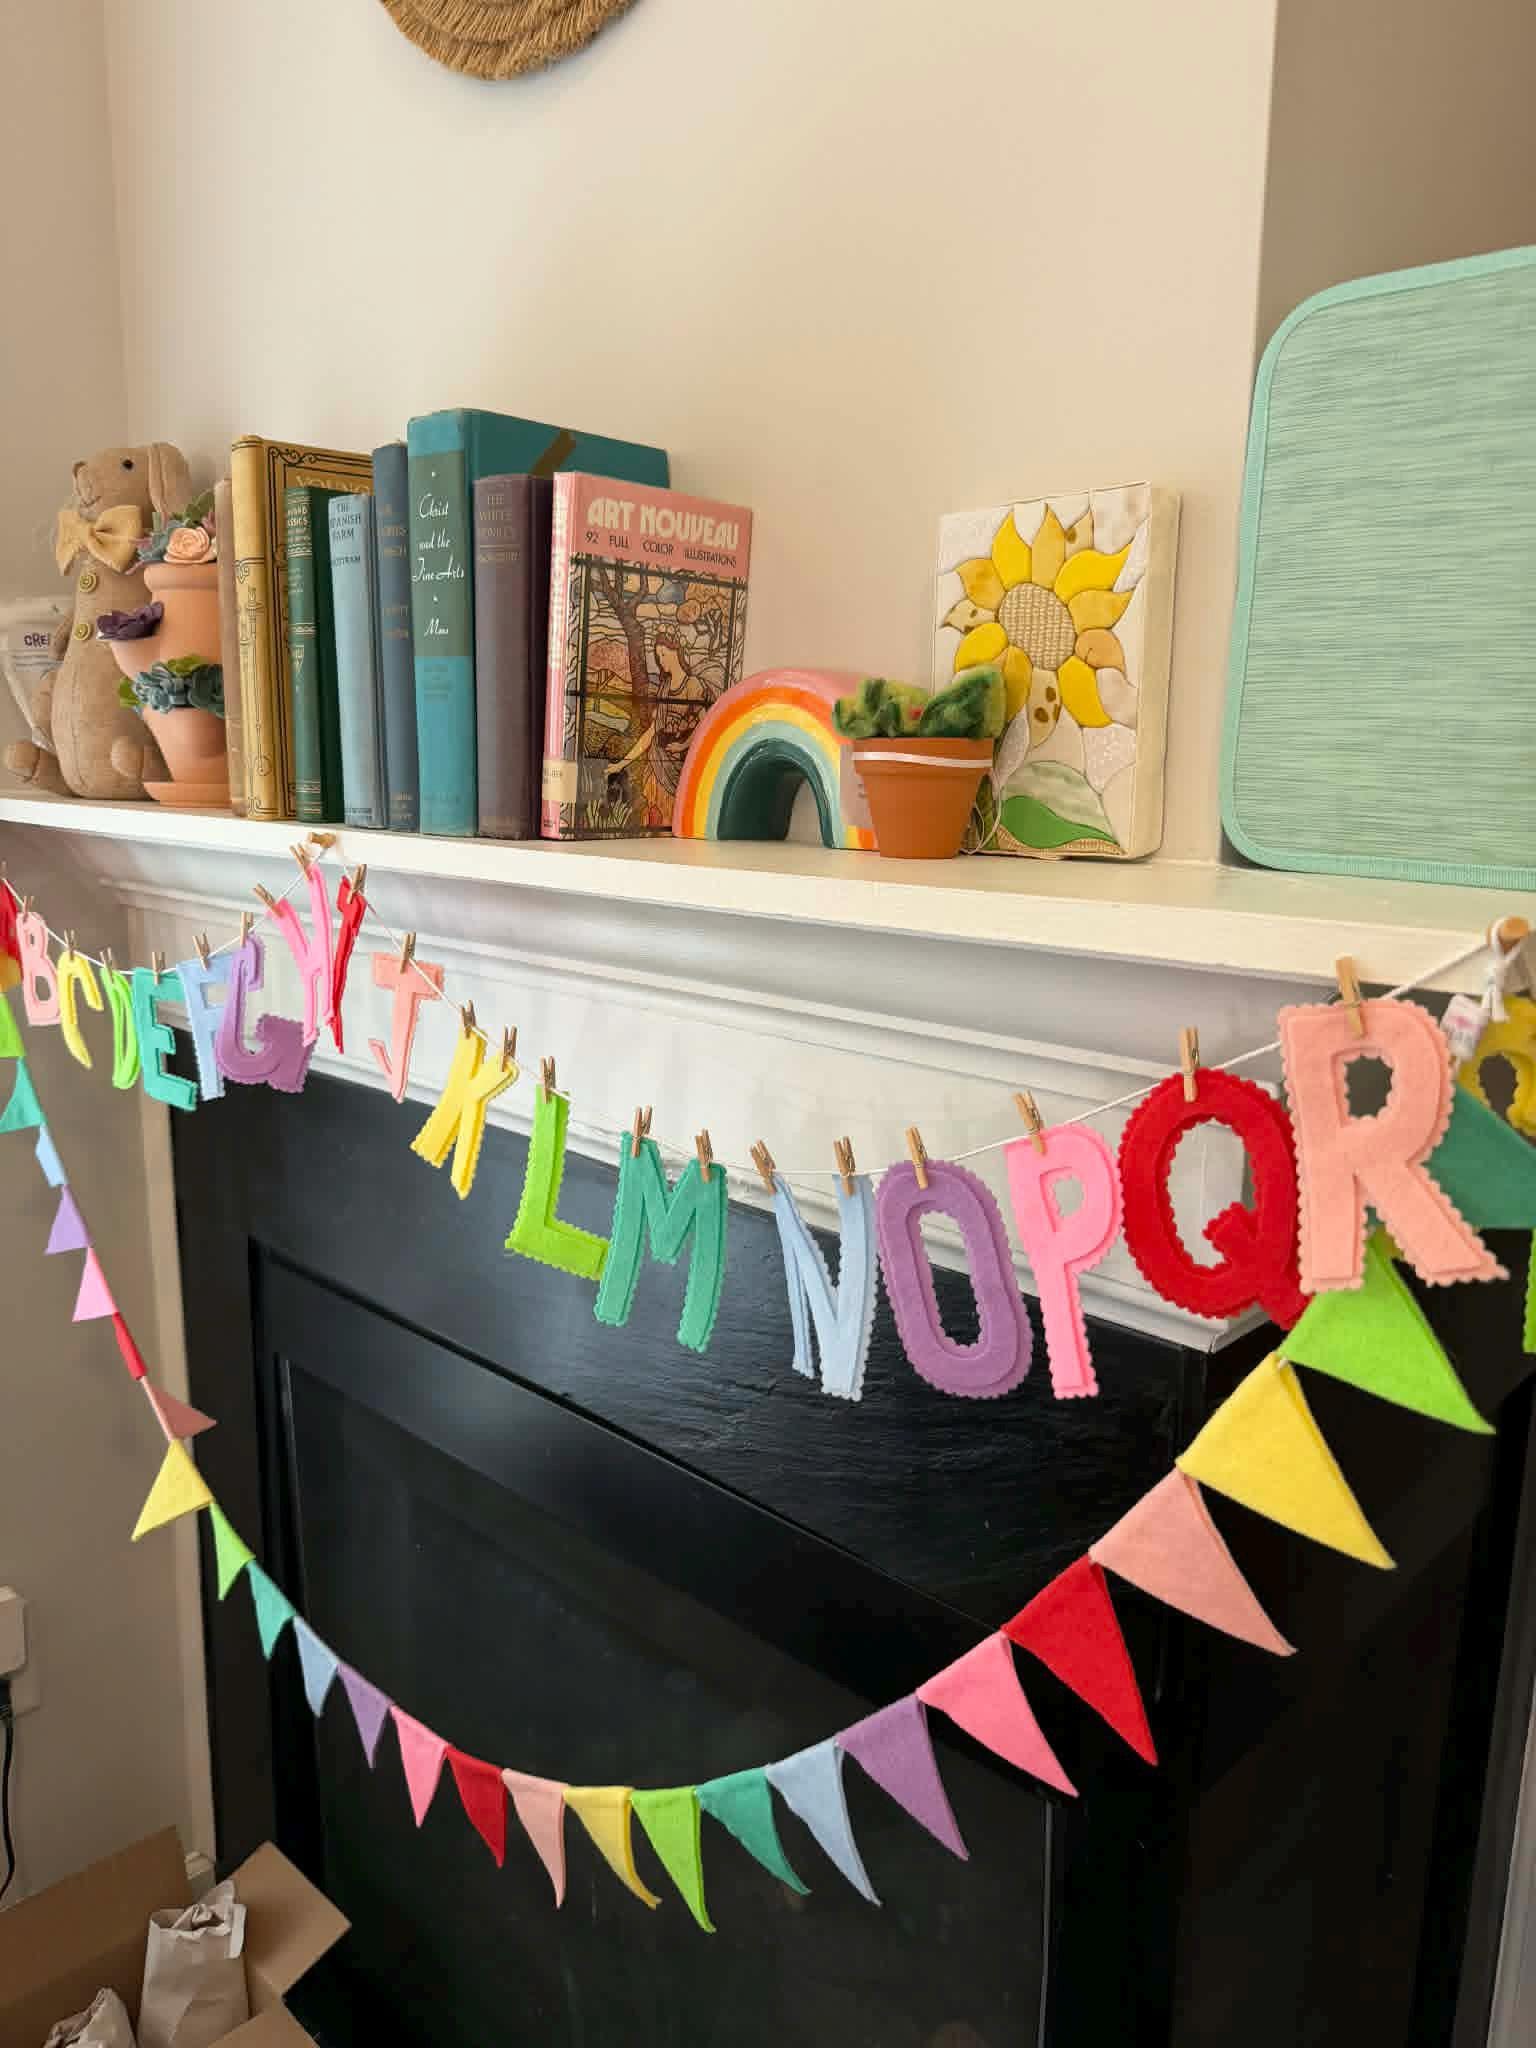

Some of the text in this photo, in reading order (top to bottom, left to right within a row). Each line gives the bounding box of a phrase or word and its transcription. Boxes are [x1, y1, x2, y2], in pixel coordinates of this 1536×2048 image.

[418, 493, 449, 519] Christ
[587, 497, 740, 550] ART NOUVEAU
[418, 531, 436, 550] and
[437, 527, 451, 549] the
[585, 531, 737, 569] 92 FULL COLOR ILLUSTRATIONS
[411, 557, 434, 582] Fine
[434, 554, 465, 580] Arts
